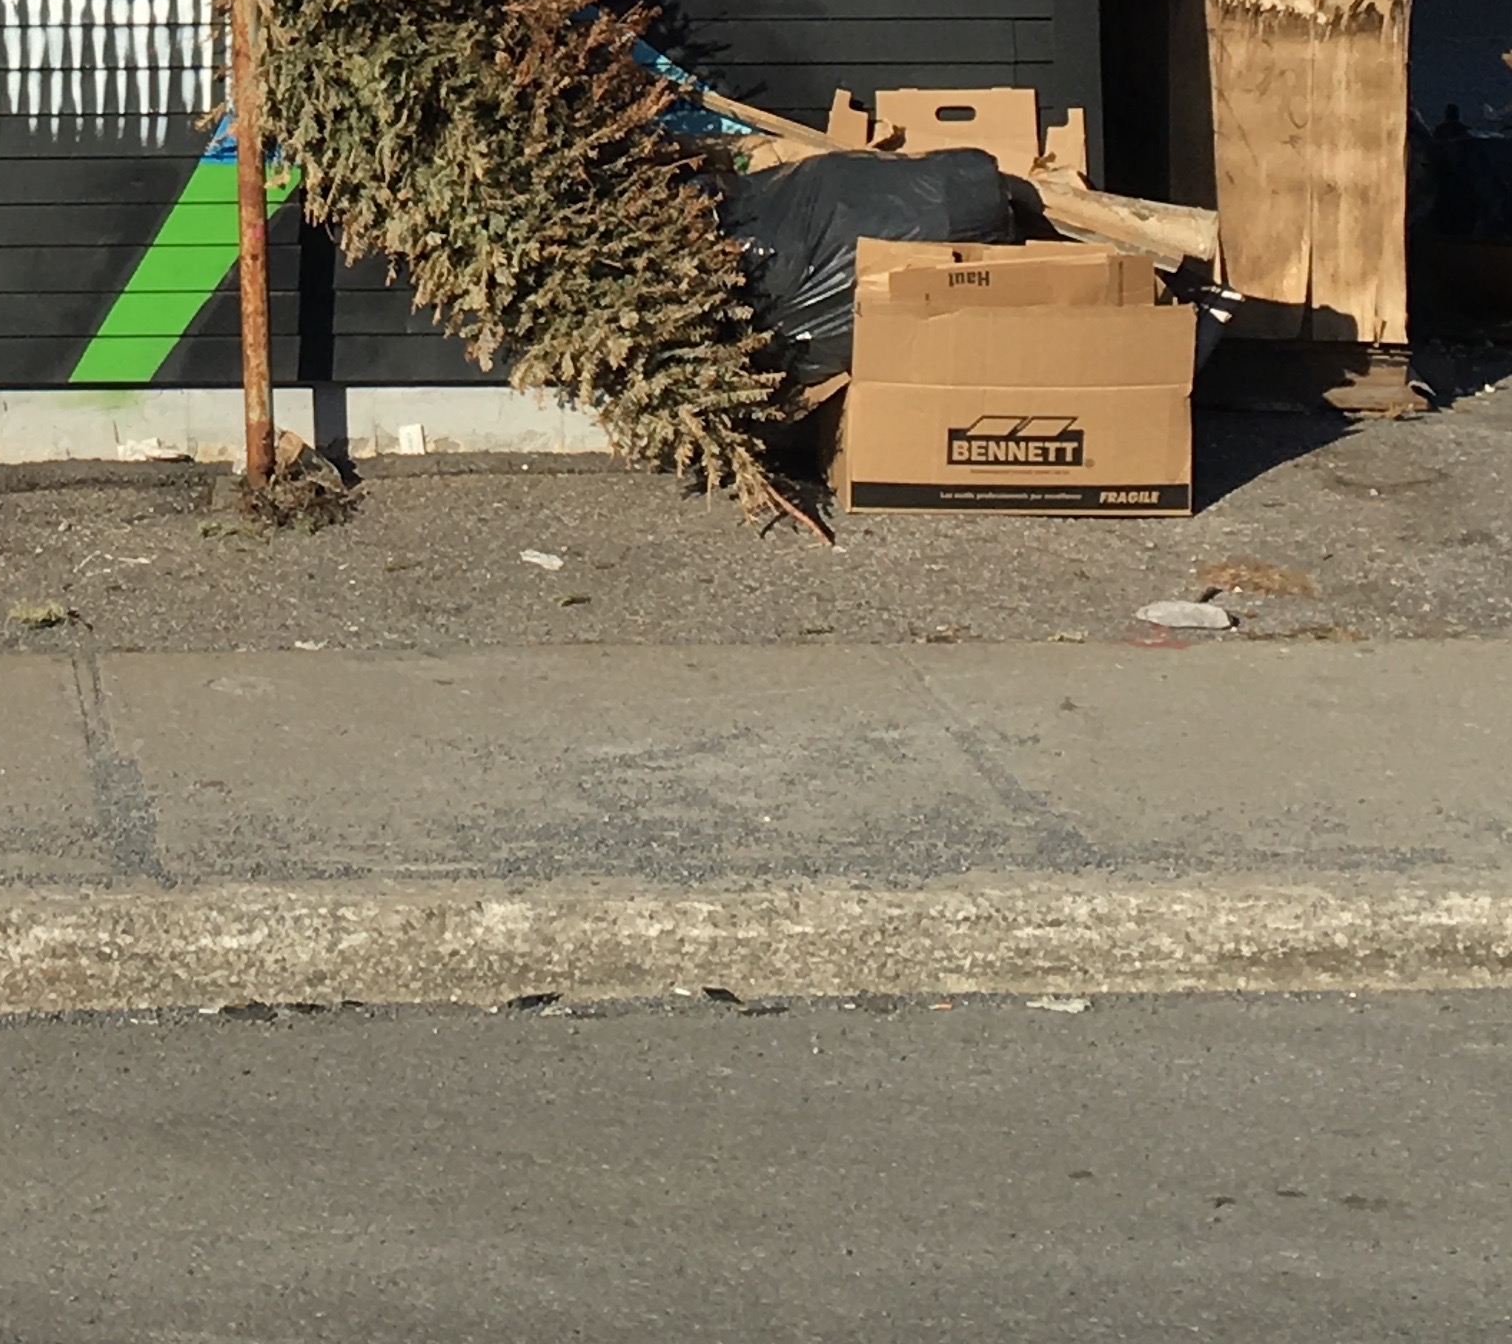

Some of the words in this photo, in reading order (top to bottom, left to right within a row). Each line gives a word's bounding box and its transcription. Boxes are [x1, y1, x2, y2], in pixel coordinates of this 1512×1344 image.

[948, 270, 990, 287] Haut
[951, 439, 1079, 463] BENNETT
[1099, 491, 1160, 505] FRAGILE
